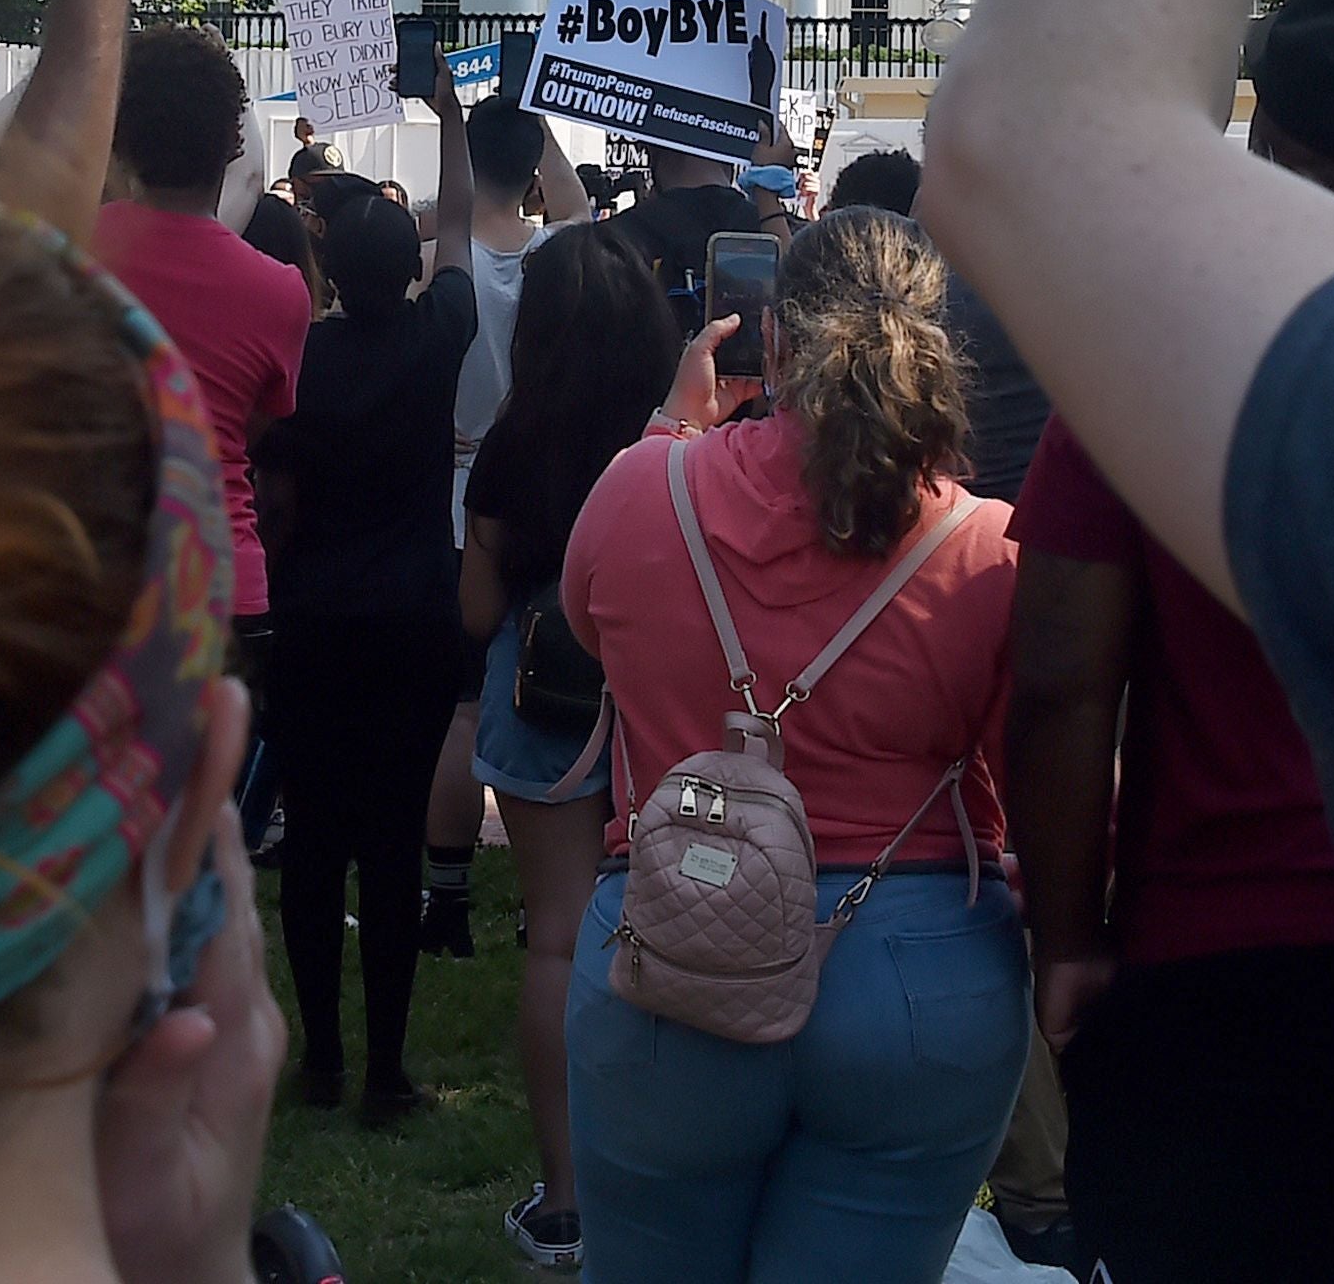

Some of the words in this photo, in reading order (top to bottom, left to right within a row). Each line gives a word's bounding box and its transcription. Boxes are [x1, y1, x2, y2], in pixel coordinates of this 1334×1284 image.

[288, 29, 312, 48] TO
[322, 20, 363, 42] BURY
[371, 18, 393, 38] US
[292, 49, 337, 73] THEY
[298, 73, 342, 97] KNOW
[347, 68, 368, 85] WE
[548, 61, 653, 100] #TrumpPence
[541, 80, 648, 126] OUTNOW!
